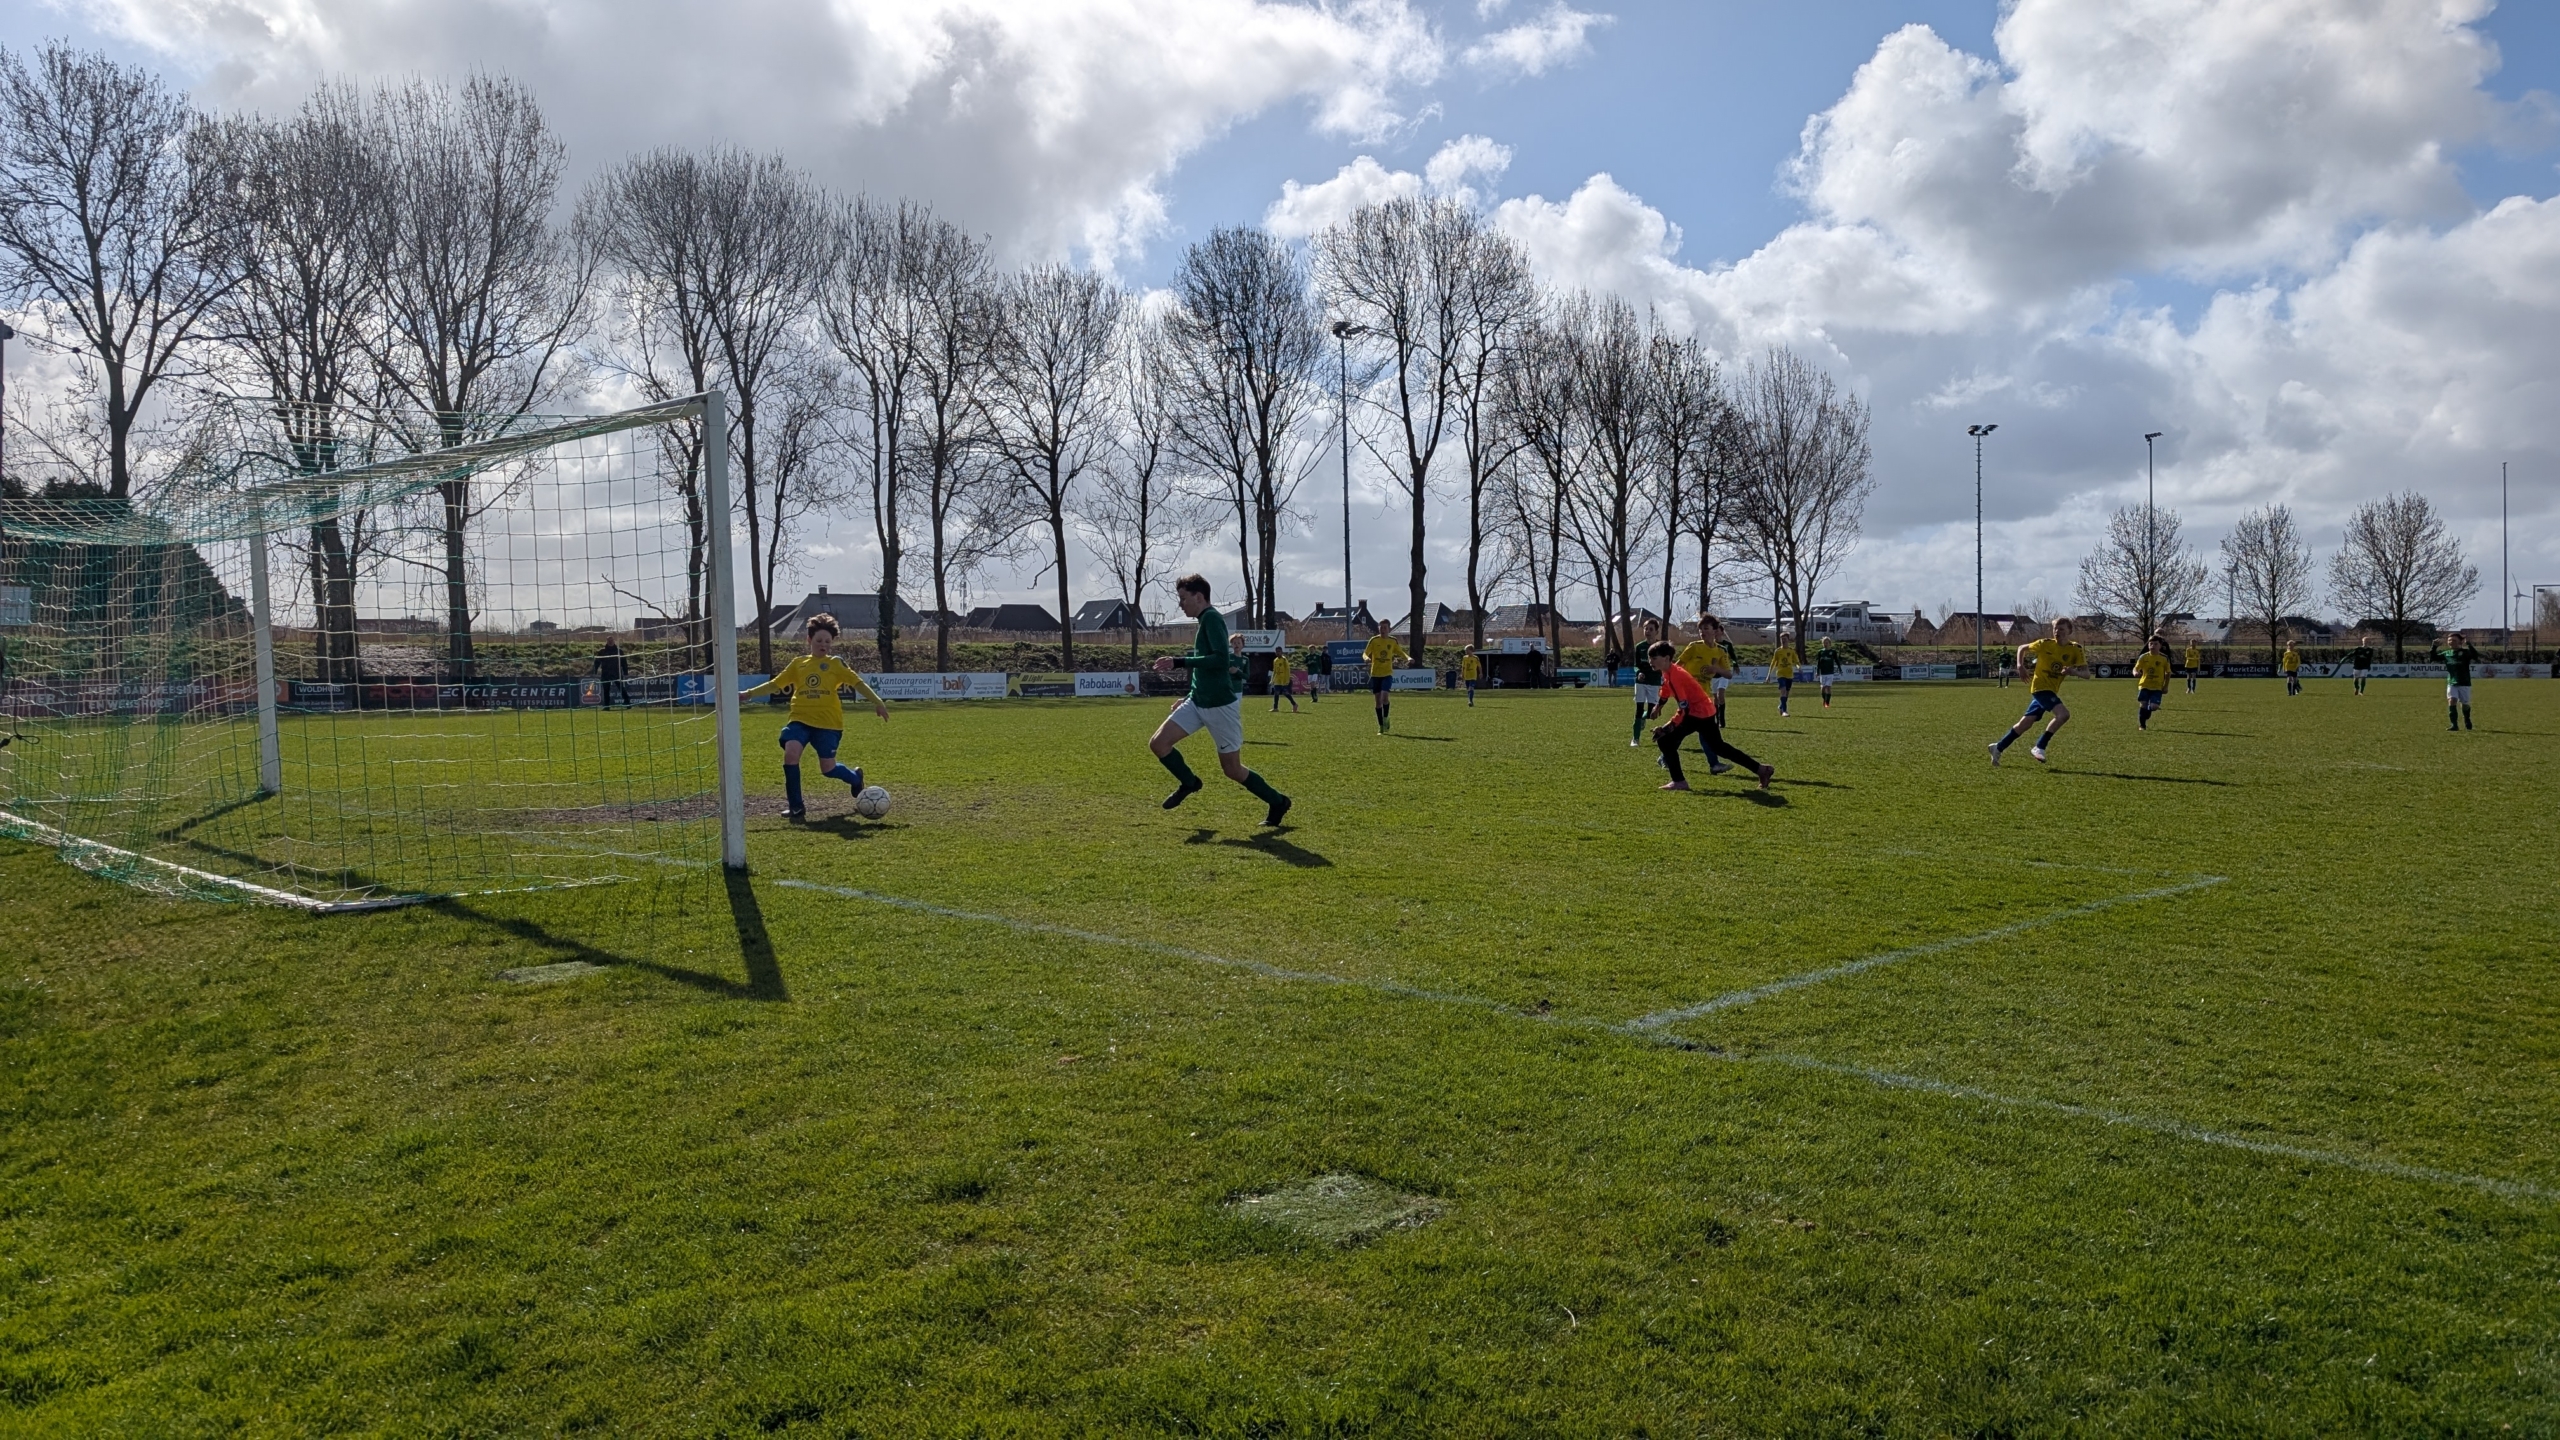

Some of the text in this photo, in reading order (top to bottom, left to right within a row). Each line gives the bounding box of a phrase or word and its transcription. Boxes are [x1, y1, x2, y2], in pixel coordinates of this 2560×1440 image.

[880, 676, 932, 686] Kantoorgroen
[943, 676, 964, 690] bak
[1080, 678, 1122, 690] Rabobank
[1400, 675, 1433, 684] Groenten
[123, 685, 149, 695] DAN
[299, 685, 341, 693] WOLDHUIS
[882, 688, 903, 696] Noord
[904, 687, 930, 696] Holland
[88, 701, 106, 711] EN
